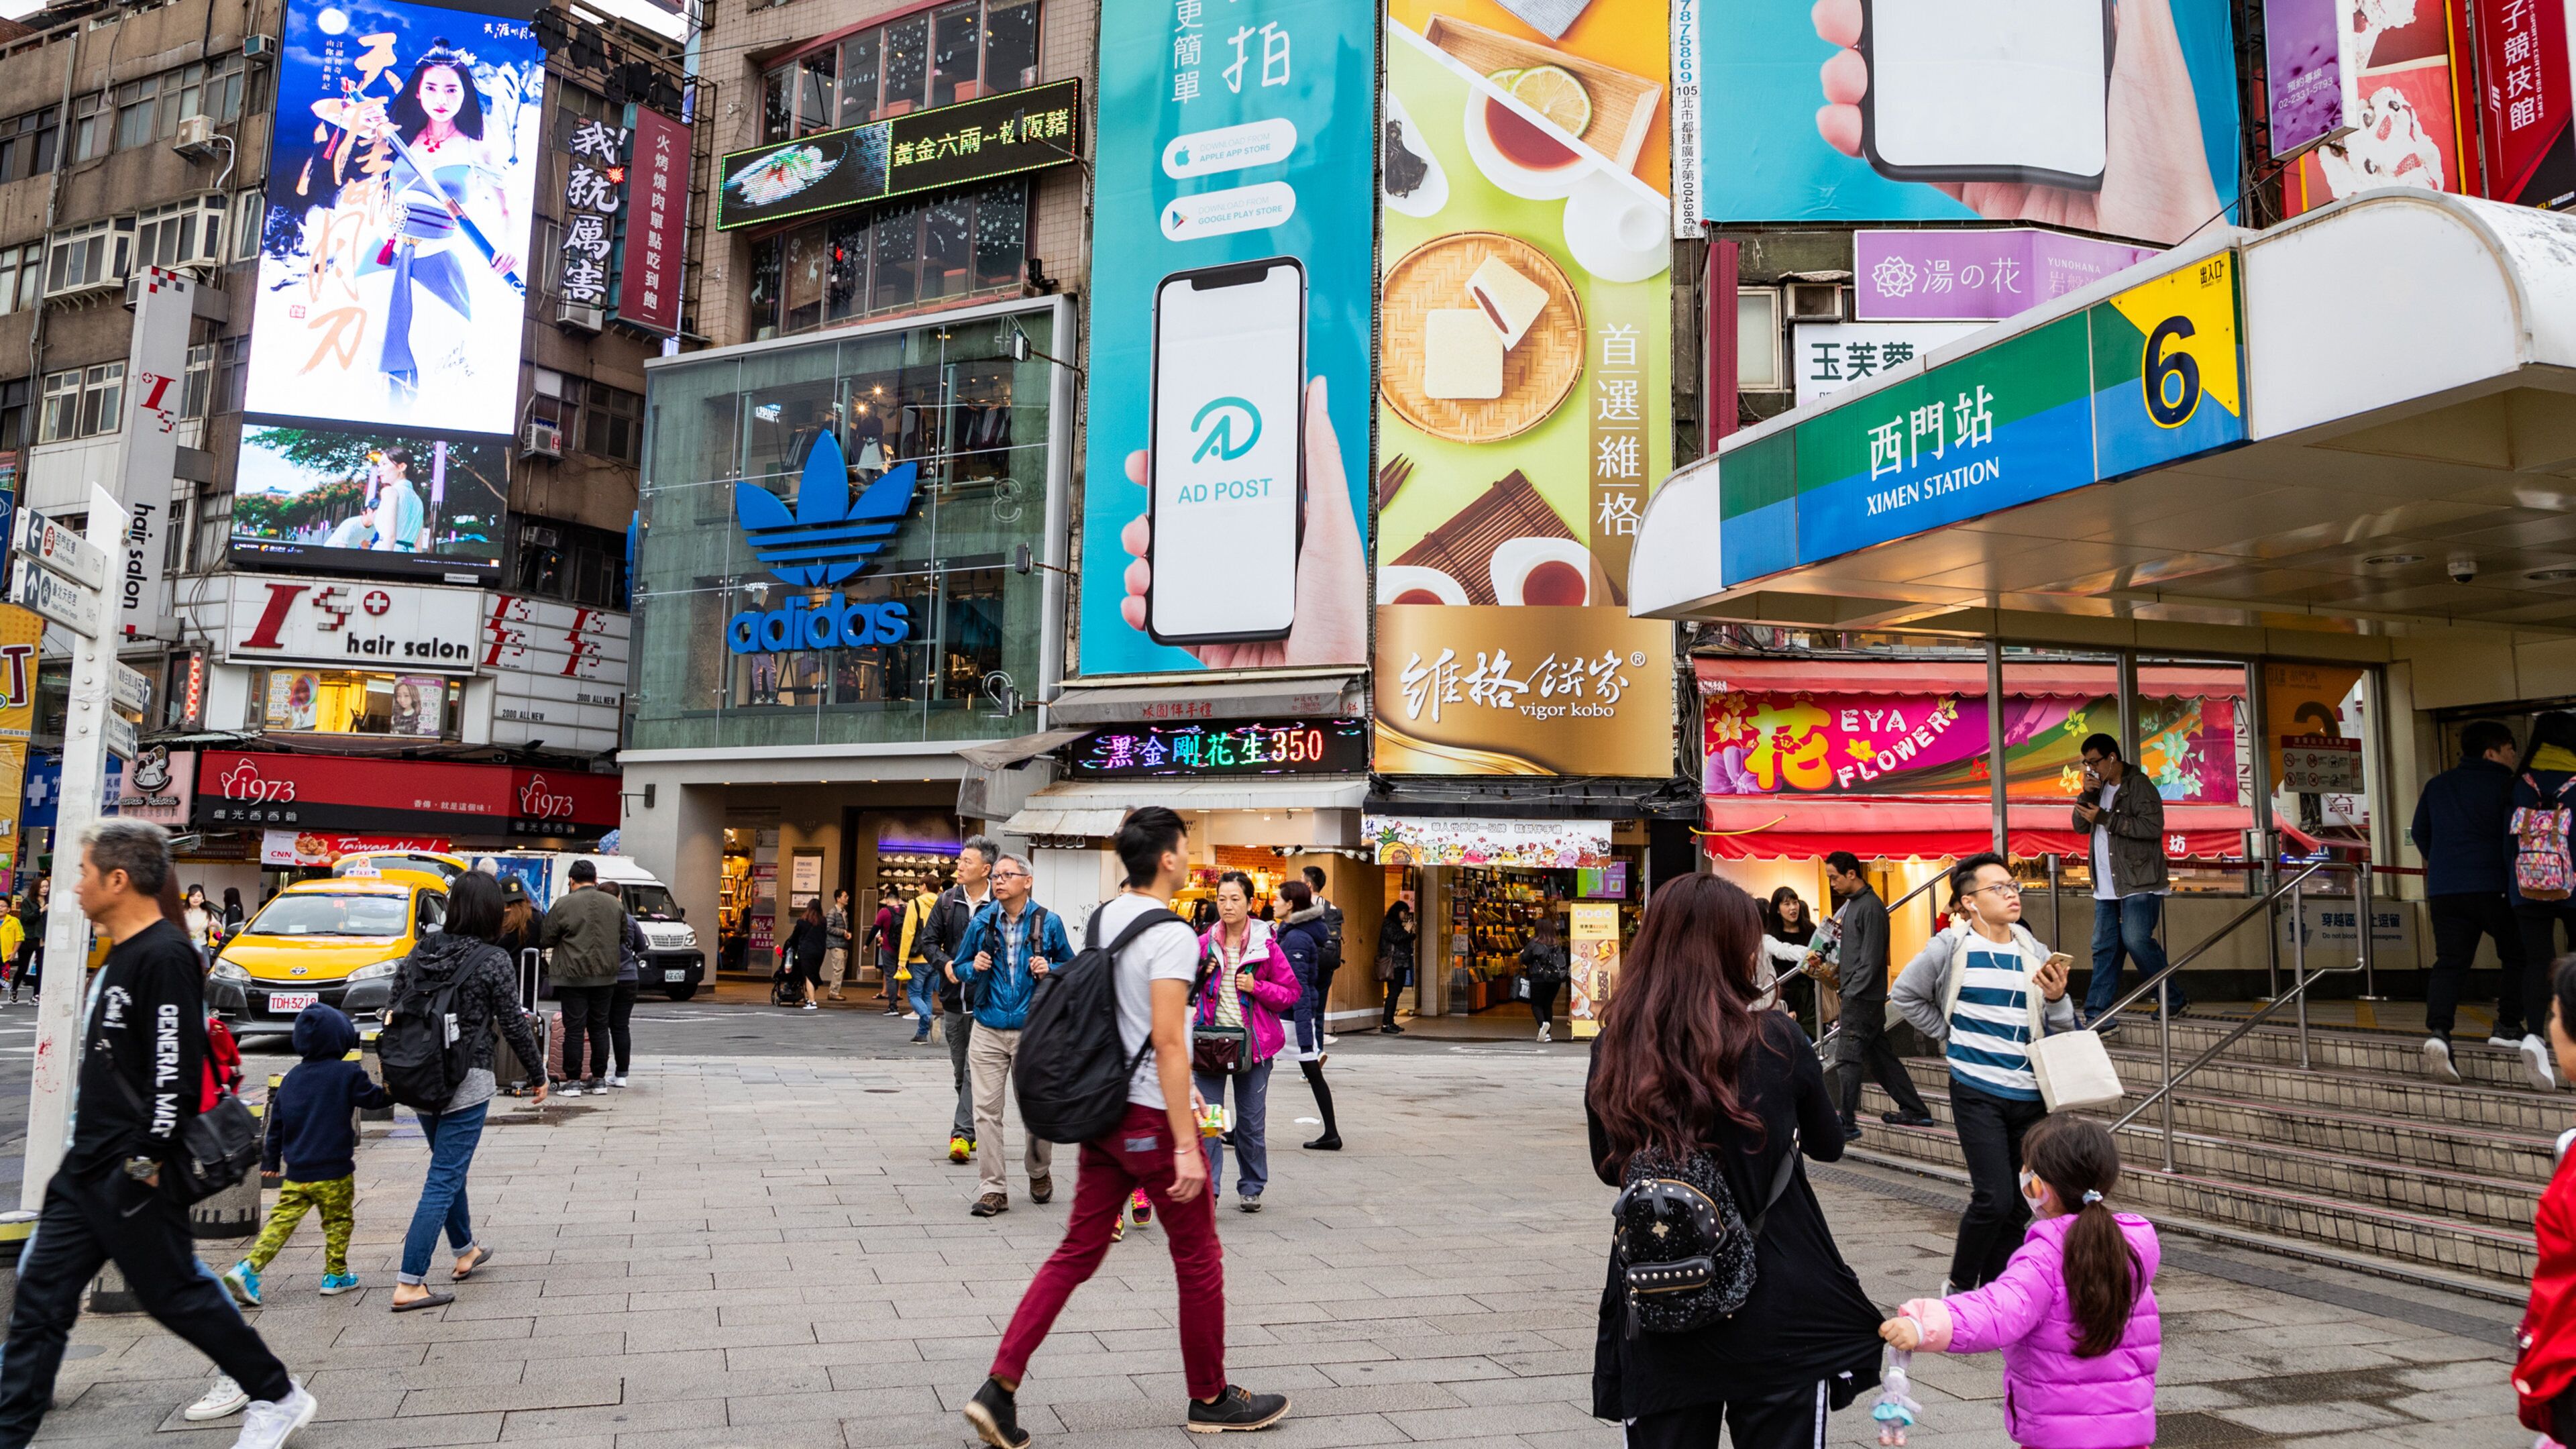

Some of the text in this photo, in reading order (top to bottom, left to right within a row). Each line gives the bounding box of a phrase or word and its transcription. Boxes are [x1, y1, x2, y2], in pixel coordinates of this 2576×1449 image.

[1222, 21, 1289, 93] 拍
[2278, 76, 2332, 109] 02-2331-5793
[1199, 143, 1271, 162] APPLE APP STORE
[1200, 132, 1271, 152] DOWNLOAD FROM
[1198, 204, 1283, 225] GOOGLE PLAY STORE
[1922, 257, 2021, 294] 湯の花
[2047, 257, 2101, 274] YUNOHANA
[2200, 260, 2222, 284] 出入口
[2143, 315, 2202, 427] 6
[1597, 323, 1641, 536] 首選維格
[1867, 384, 1994, 482] 西門站
[1178, 477, 1273, 504] AD POST
[1867, 457, 2000, 517] XIMEN STATION
[123, 502, 156, 609] hair salon
[727, 593, 909, 654] adidas
[347, 633, 469, 659] hair salon
[1399, 648, 1629, 722] 維格餅家
[577, 693, 616, 705] 2000 ALL NEW
[1520, 701, 1615, 721] vigor kobo
[502, 709, 545, 721] 2000 ALL NEW
[1840, 709, 1907, 733] EYA
[1744, 702, 1834, 790] 花
[1836, 710, 1951, 788] FLOWER
[270, 850, 292, 859] CNN
[337, 837, 390, 852] Taiwan
[2169, 835, 2186, 853] 坊
[156, 1004, 179, 1088] GENERAL
